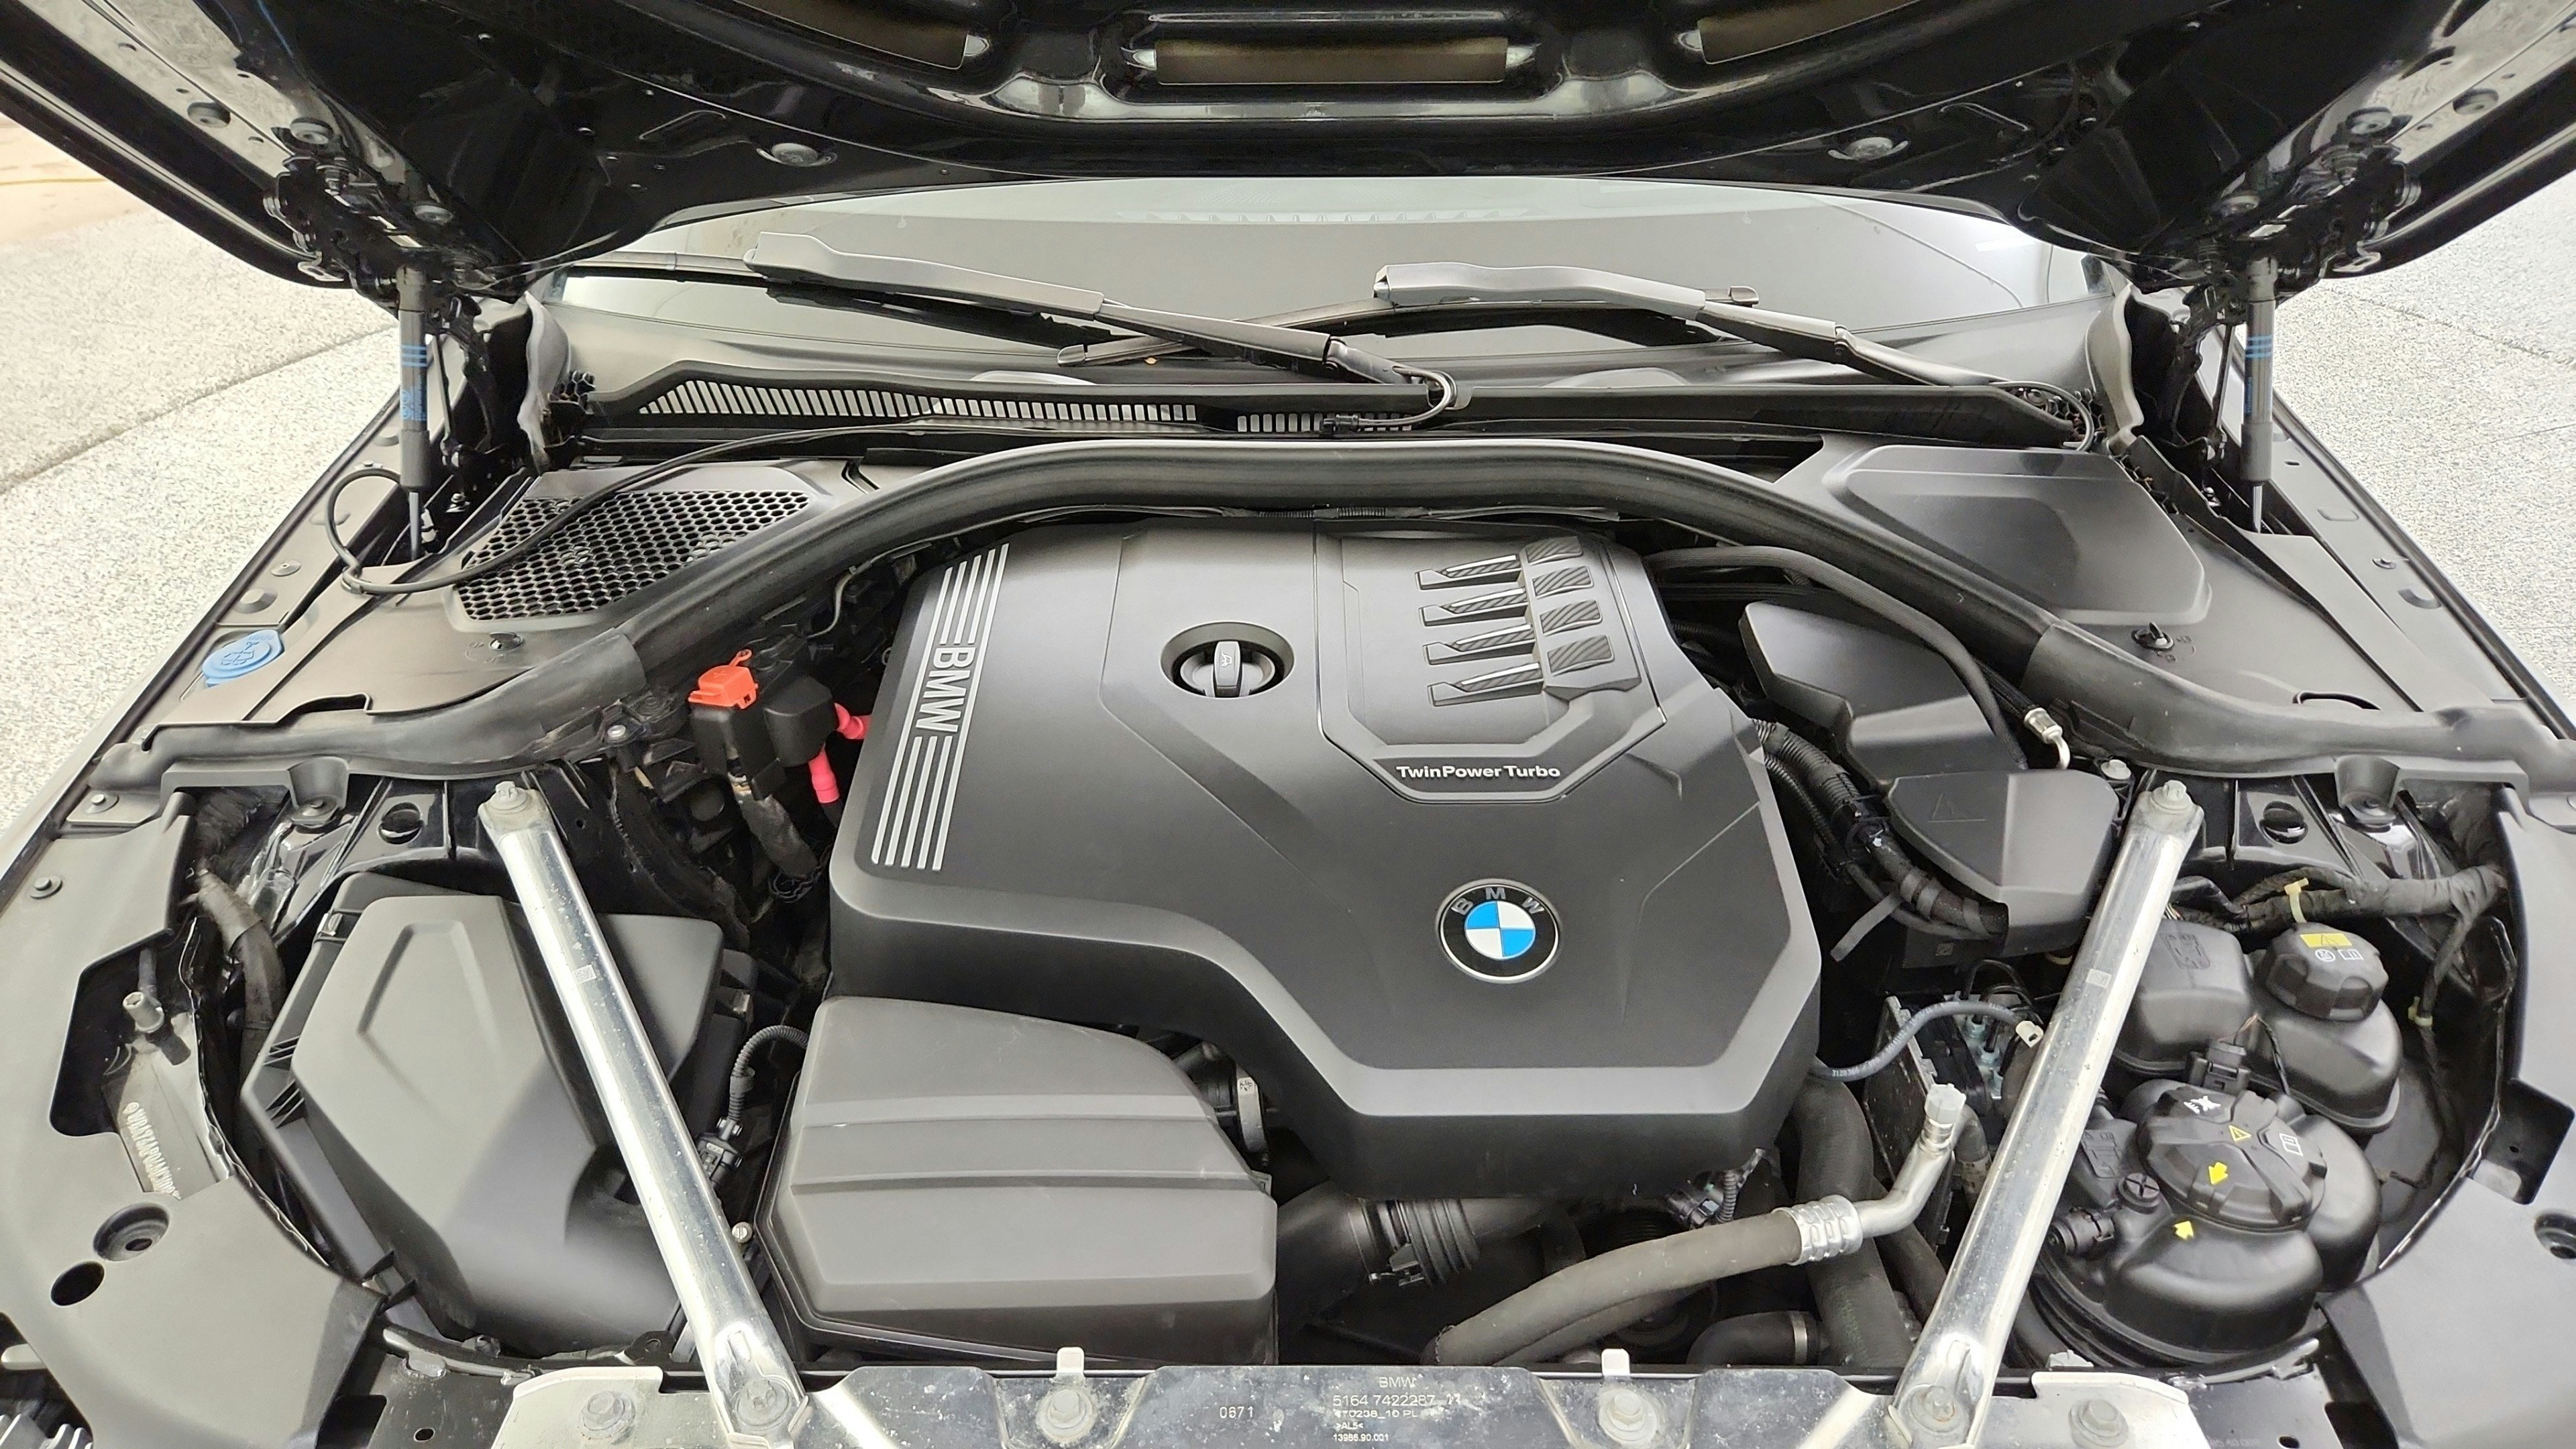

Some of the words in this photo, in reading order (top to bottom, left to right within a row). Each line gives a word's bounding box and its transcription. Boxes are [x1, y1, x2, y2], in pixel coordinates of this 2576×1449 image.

[916, 647, 975, 732] BMW
[1396, 765, 1502, 778] TwinPower
[1503, 765, 1561, 778] Turbo
[1451, 887, 1544, 916] BMW
[1379, 1377, 1417, 1388] BMW
[1333, 1395, 1368, 1406] 5164
[1373, 1395, 1436, 1407] 7422287
[1403, 1410, 1417, 1418] PL
